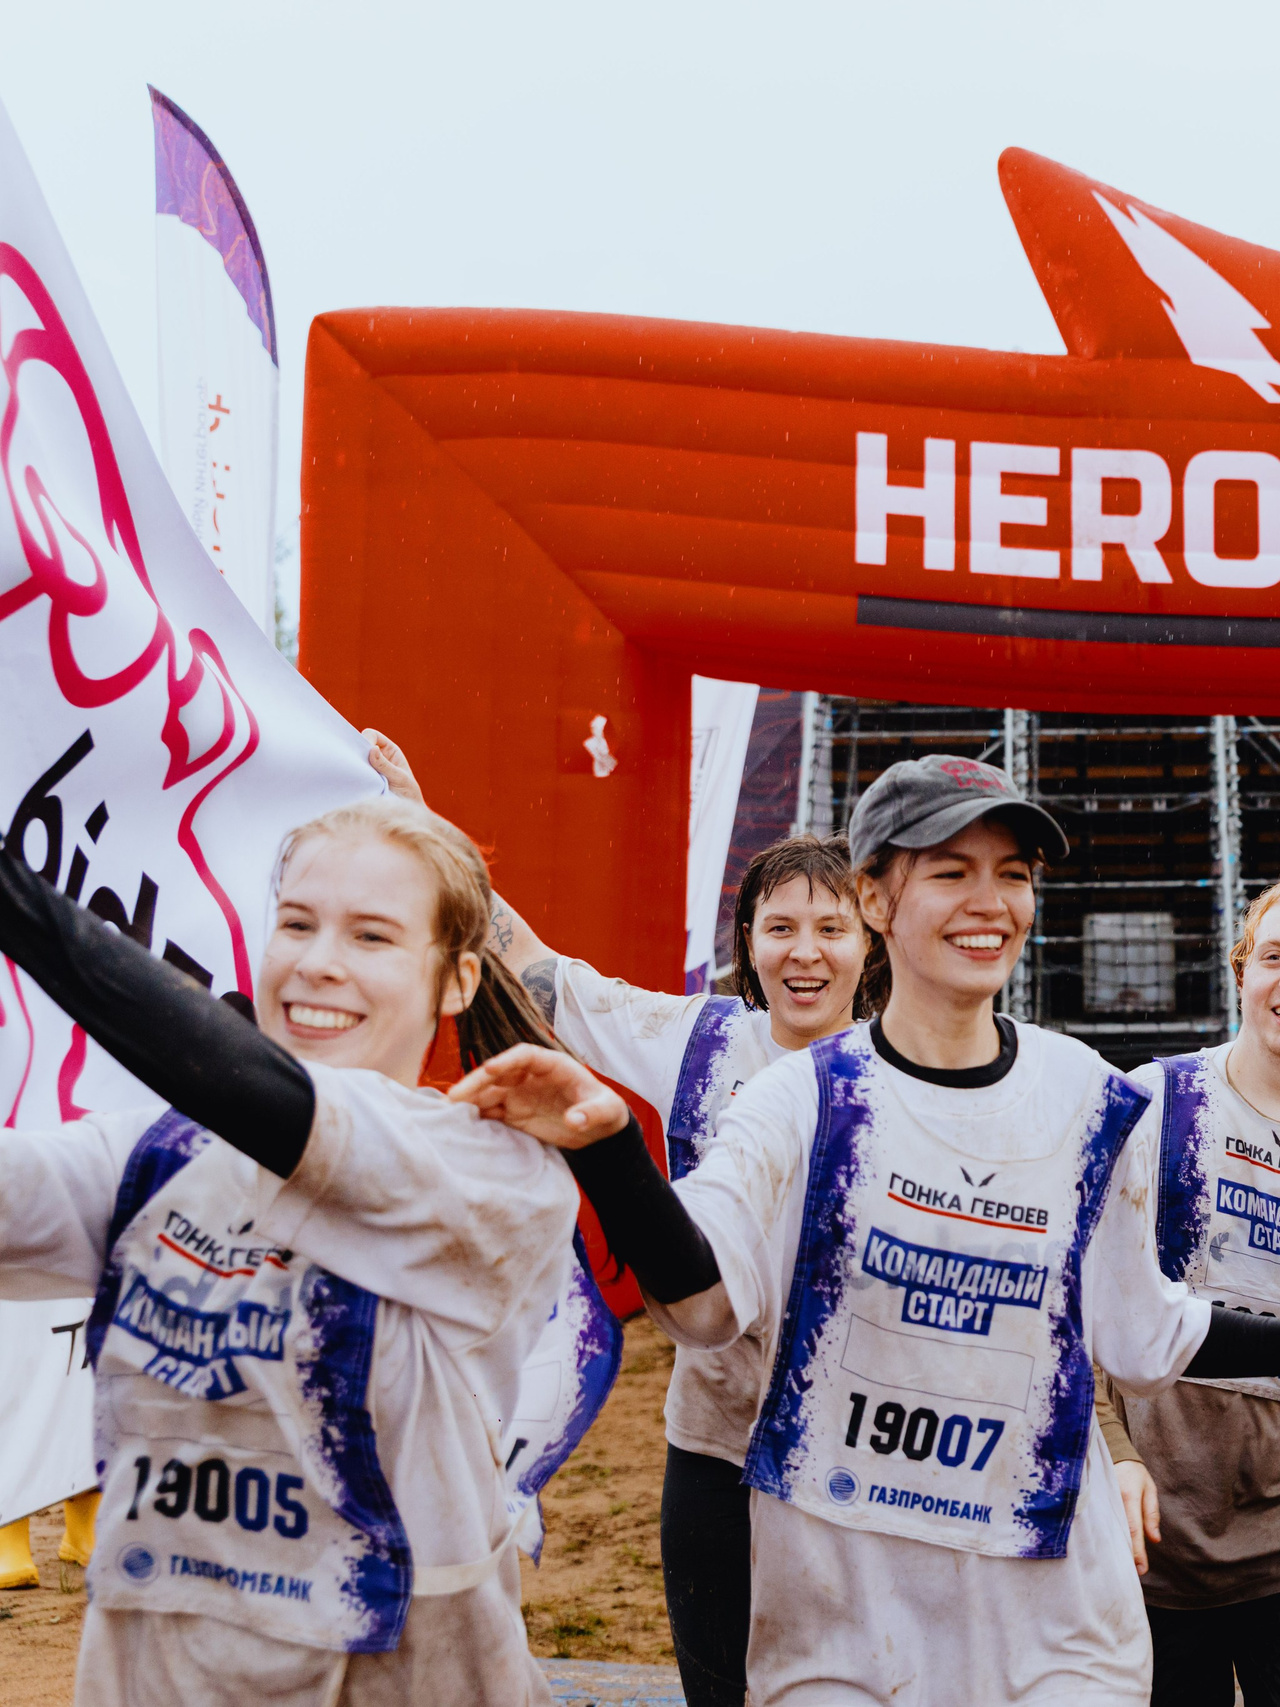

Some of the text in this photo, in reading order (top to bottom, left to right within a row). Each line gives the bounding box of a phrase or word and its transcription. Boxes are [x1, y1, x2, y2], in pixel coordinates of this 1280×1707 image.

[1226, 1136, 1273, 1166] ГОНКА
[889, 1172, 1049, 1226] ГОНКА ГЕРОЕВ
[164, 1210, 225, 1266] ГОНК
[866, 1234, 1045, 1302] КОМАНДНЫЙ
[907, 1290, 990, 1331] СТАРТ
[845, 1391, 1006, 1471] 19007
[126, 1455, 309, 1539] 19005
[868, 1484, 993, 1524] ГАЗПРОМБАНК
[170, 1554, 314, 1602] ГАЗПРОМБАНК
